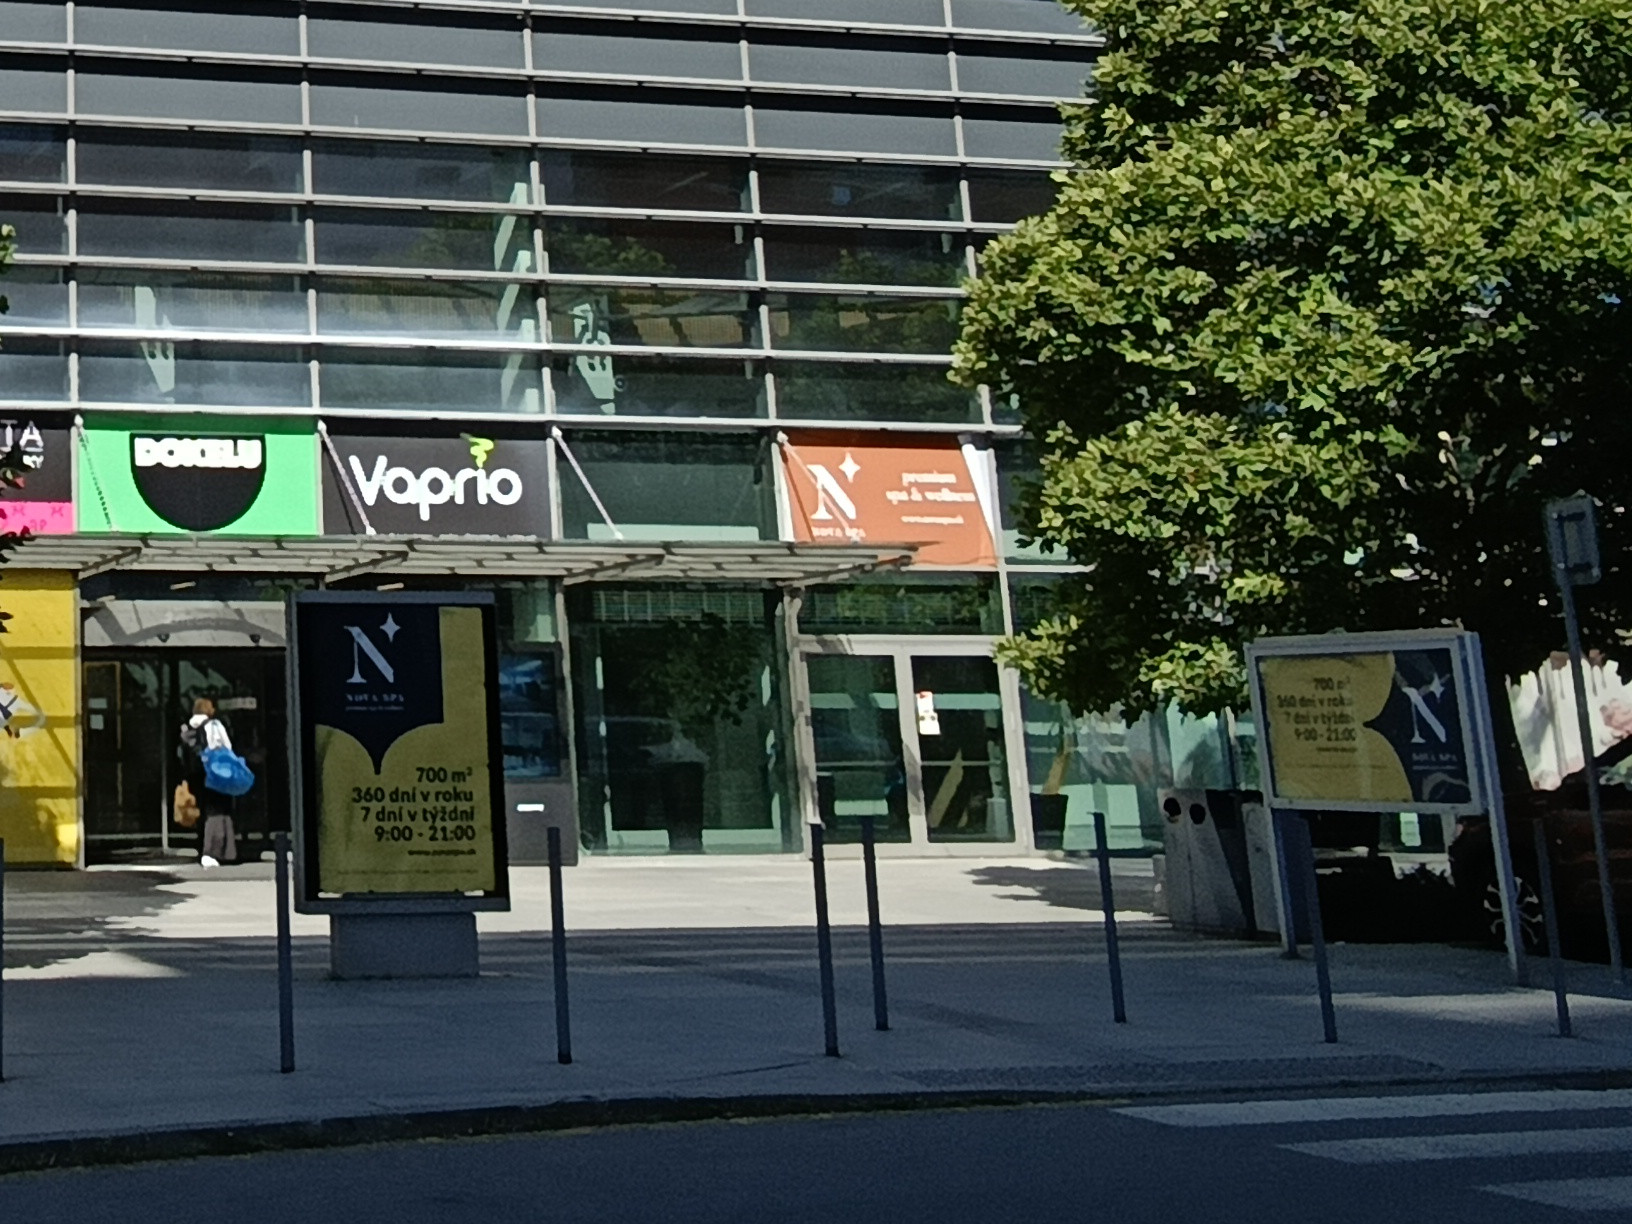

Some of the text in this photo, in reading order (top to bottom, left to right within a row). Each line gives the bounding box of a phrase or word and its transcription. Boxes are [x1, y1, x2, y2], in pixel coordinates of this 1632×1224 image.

[348, 452, 524, 522] Vaprio
[416, 766, 448, 783] 700
[352, 786, 386, 803] 360
[420, 790, 430, 803] v
[434, 786, 474, 803] roku
[360, 806, 371, 823] 7
[407, 810, 418, 823] v
[374, 825, 414, 842] 9:00
[428, 825, 477, 842] 21:00
